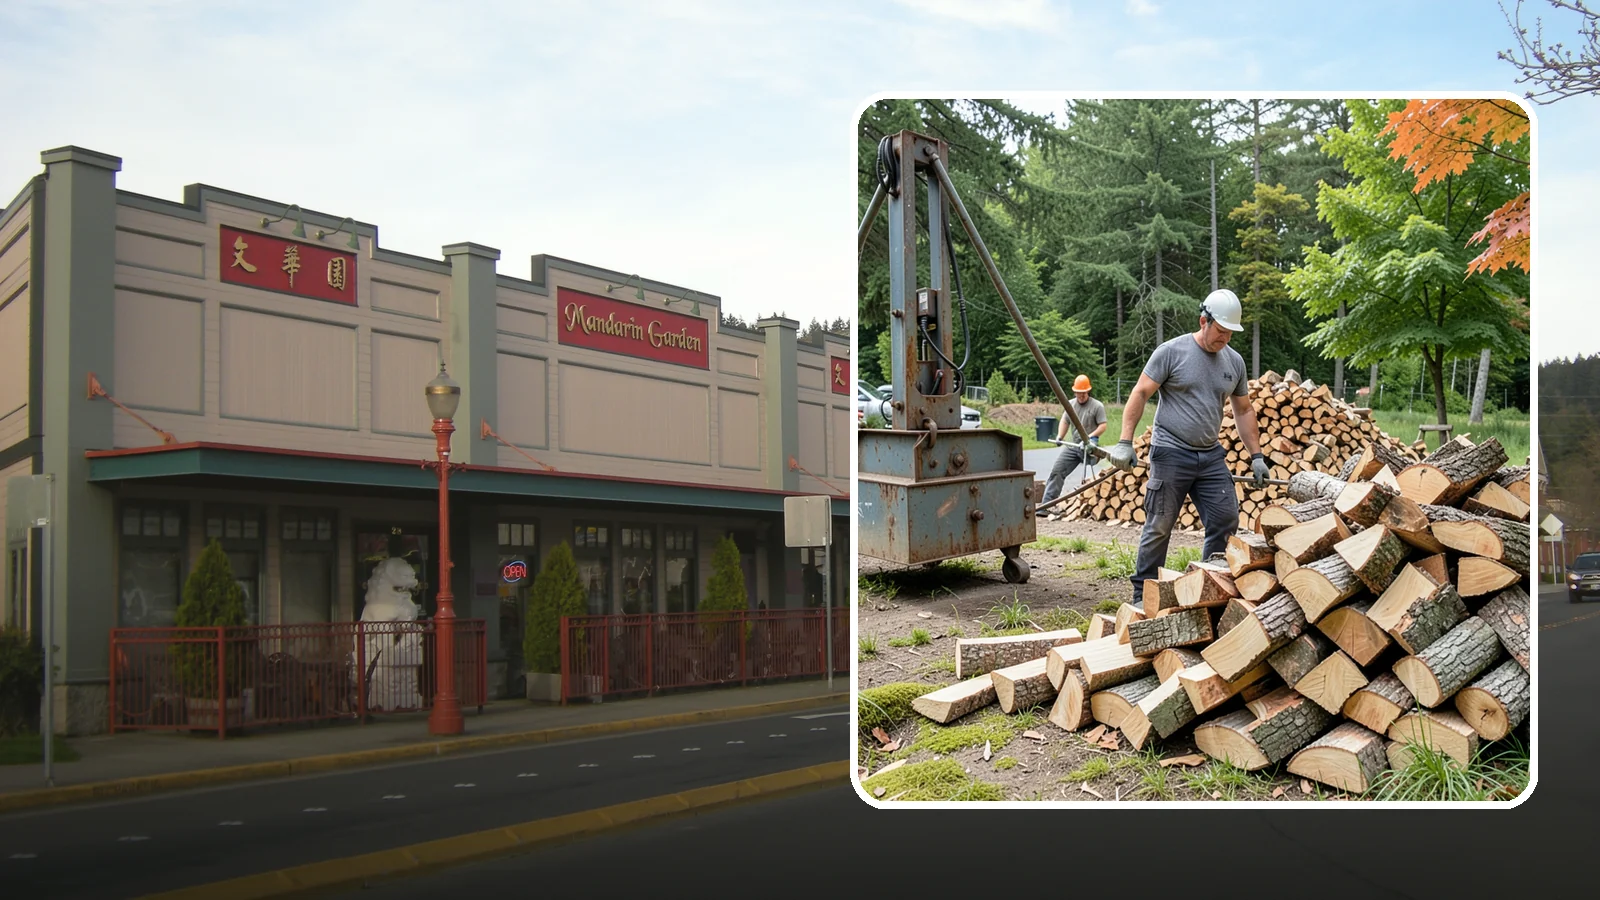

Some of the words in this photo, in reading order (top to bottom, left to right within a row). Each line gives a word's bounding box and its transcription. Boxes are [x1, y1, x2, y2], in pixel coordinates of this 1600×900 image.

[230, 235, 346, 291] 文華園
[564, 302, 644, 341] Mandarin
[648, 320, 701, 352] Garden
[503, 565, 527, 578] OPEN
